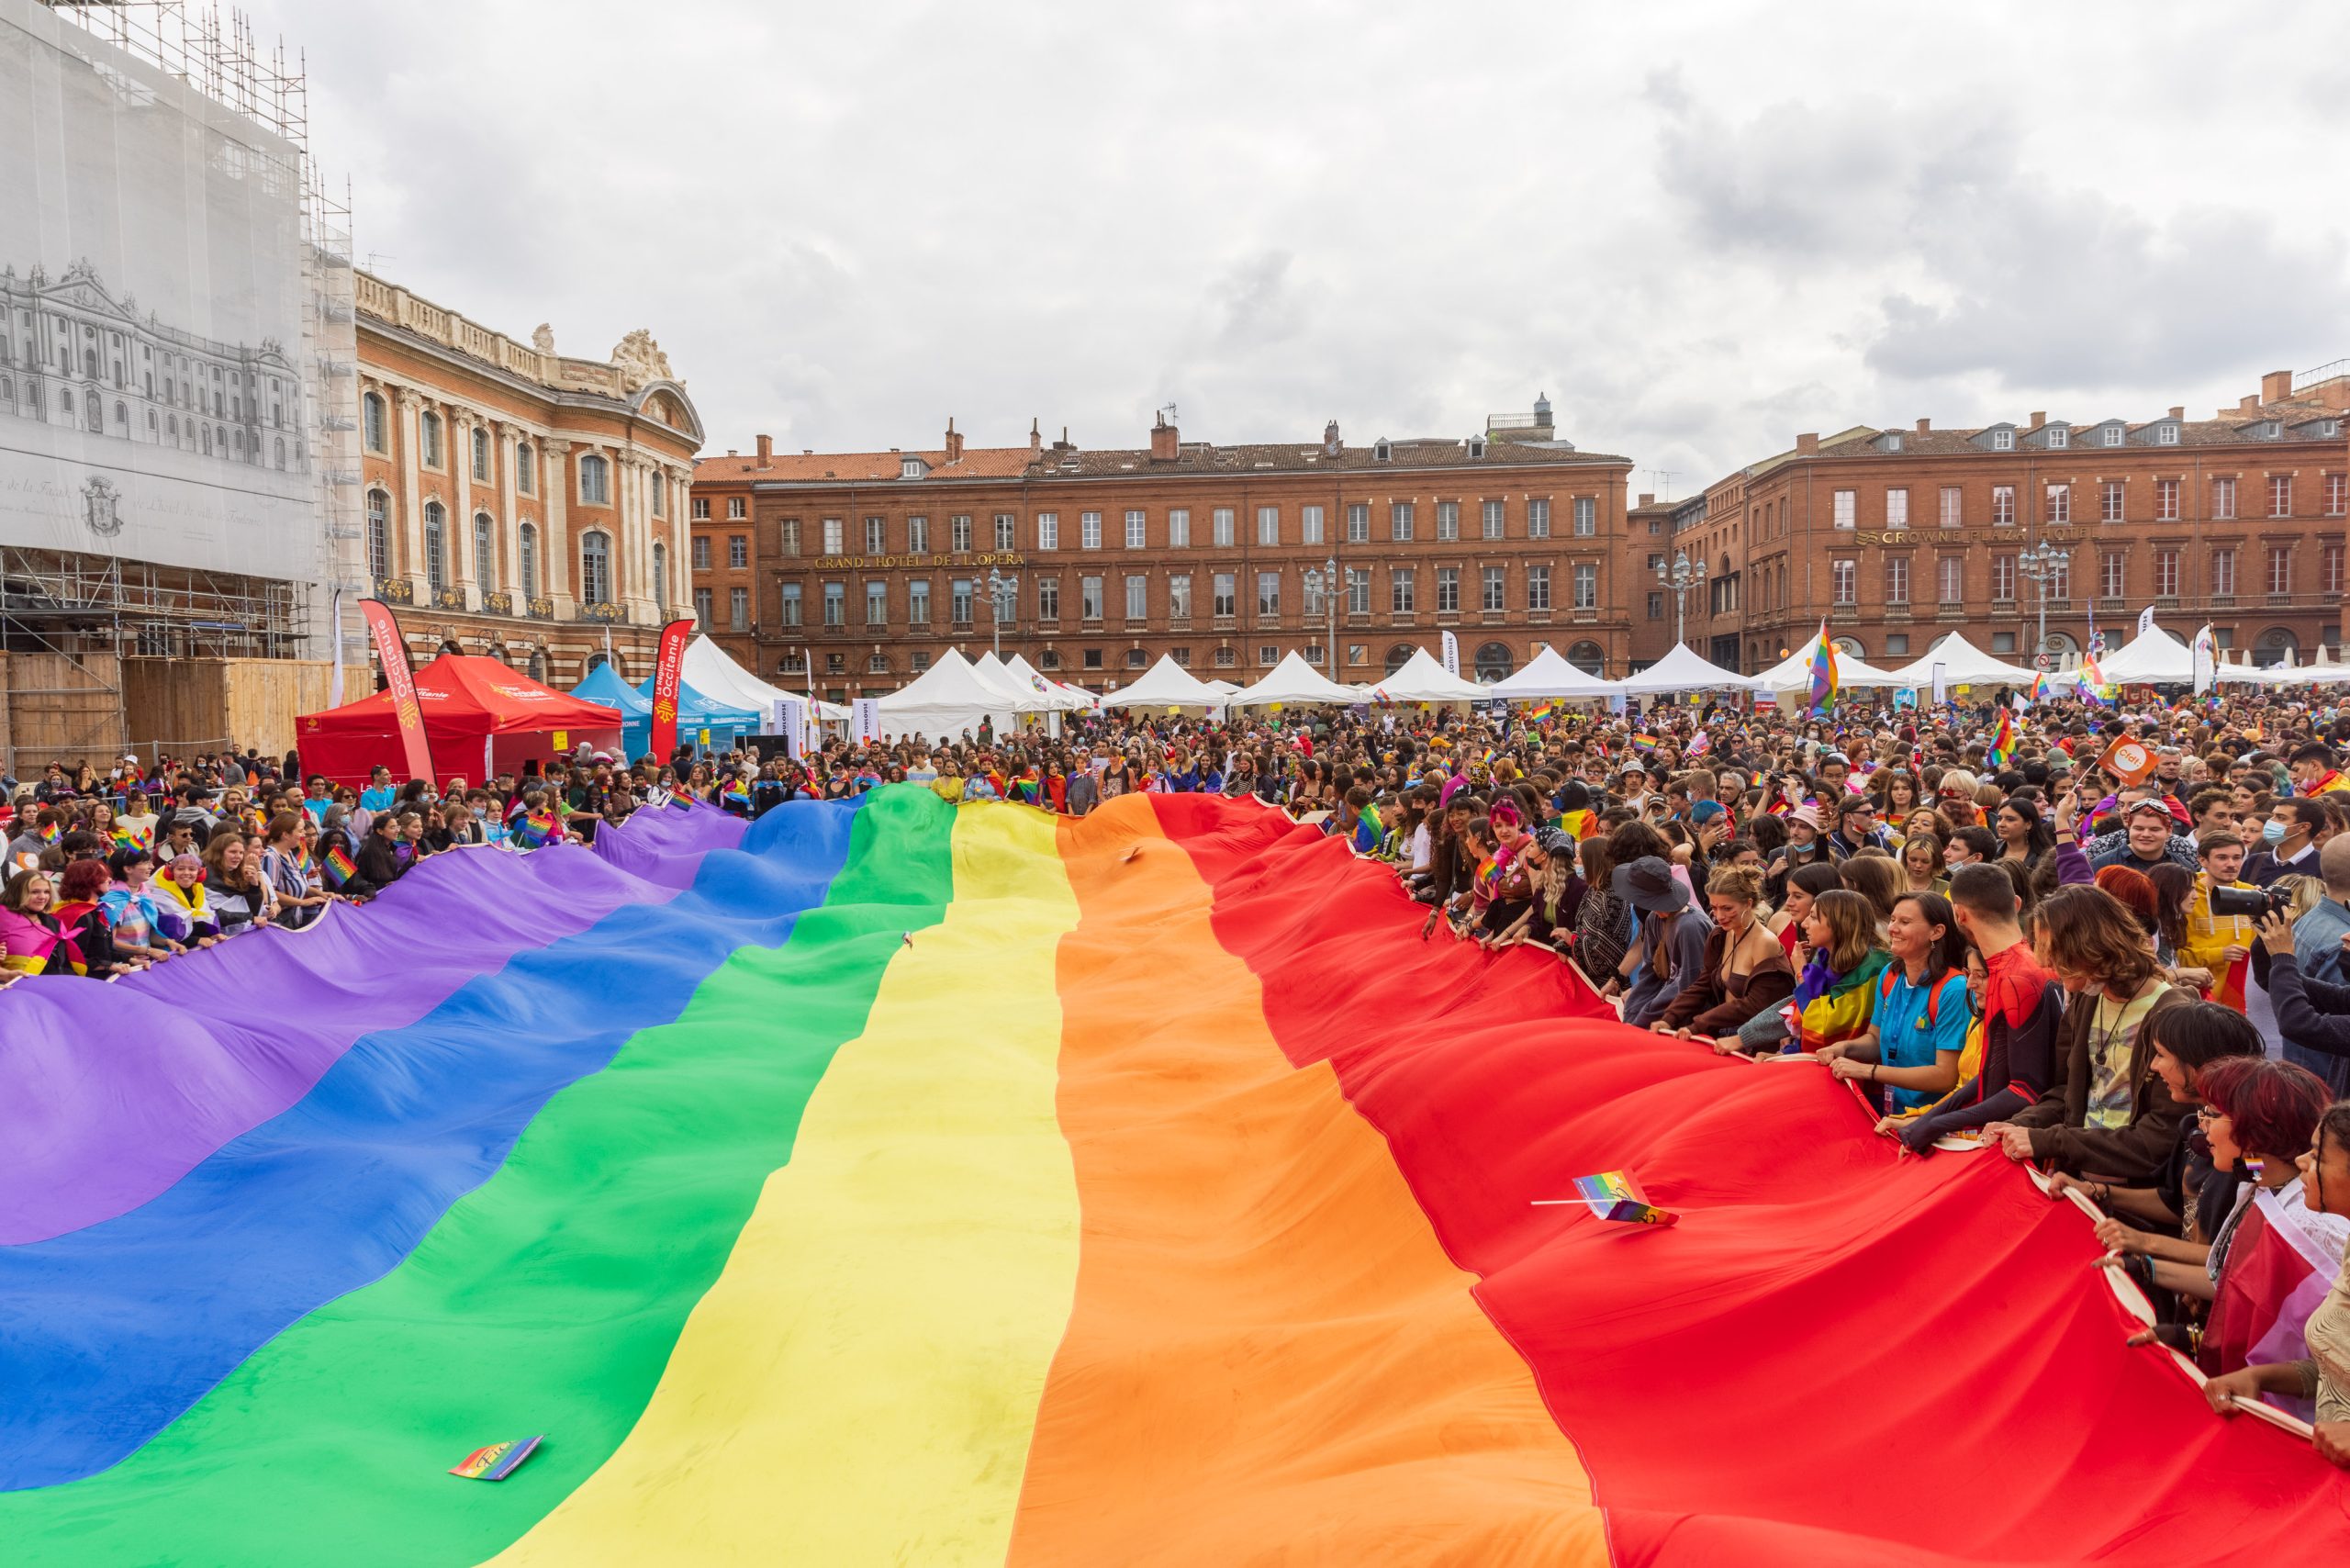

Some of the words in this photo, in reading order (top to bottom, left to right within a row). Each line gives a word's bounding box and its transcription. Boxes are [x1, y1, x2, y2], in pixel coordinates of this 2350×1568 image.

[1882, 532, 1960, 544] CROWNE
[1972, 530, 2026, 542] PLAZA
[2038, 528, 2098, 540] HOTEL
[815, 557, 864, 569] GRAND
[876, 555, 921, 567] HOTEL
[934, 555, 952, 566] DE
[662, 634, 679, 698] Occitanie
